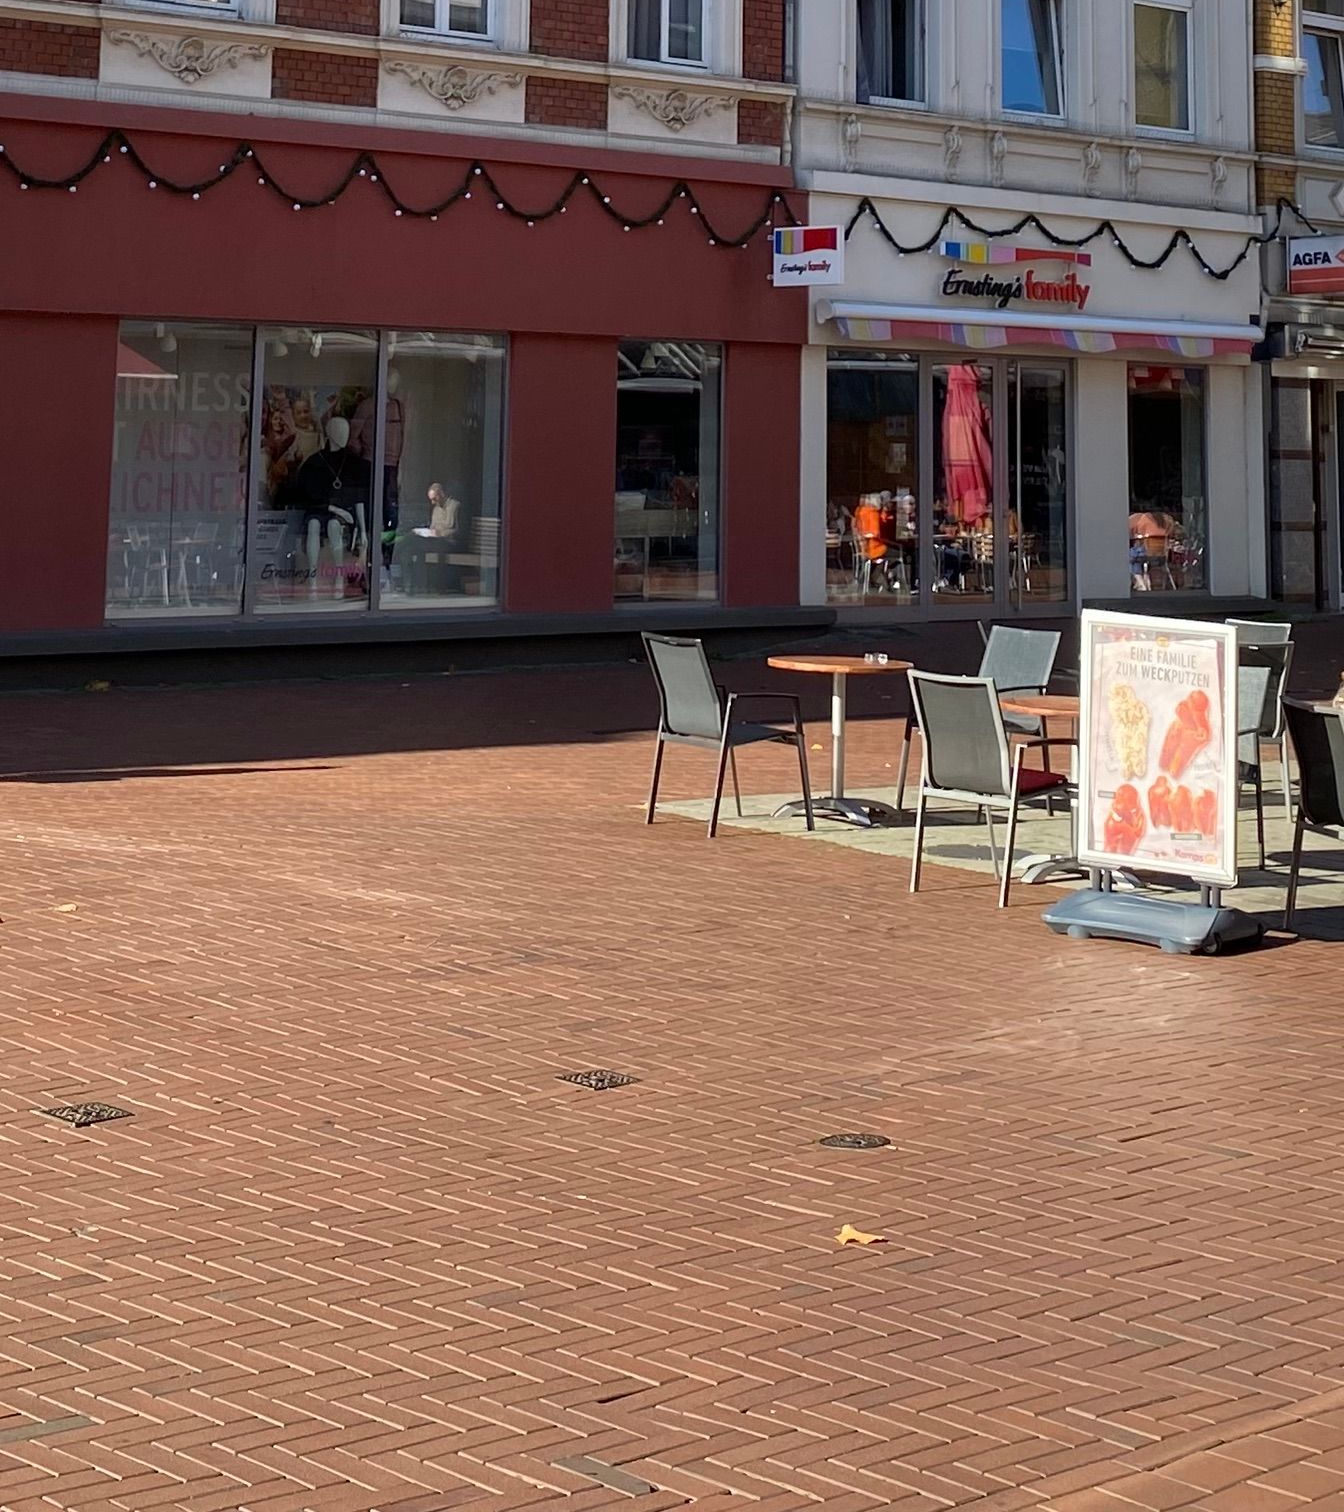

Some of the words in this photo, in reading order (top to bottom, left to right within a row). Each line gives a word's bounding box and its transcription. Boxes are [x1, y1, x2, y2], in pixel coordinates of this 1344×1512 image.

[808, 260, 831, 272] family
[1293, 251, 1332, 266] AGFA
[942, 269, 1023, 308] Ernsting's
[1024, 269, 1090, 310] family
[1130, 646, 1153, 663] EINE
[1157, 650, 1197, 669] FAMILIE
[1116, 661, 1138, 678] ZUM
[1141, 664, 1210, 689] WECKPUTZEN
